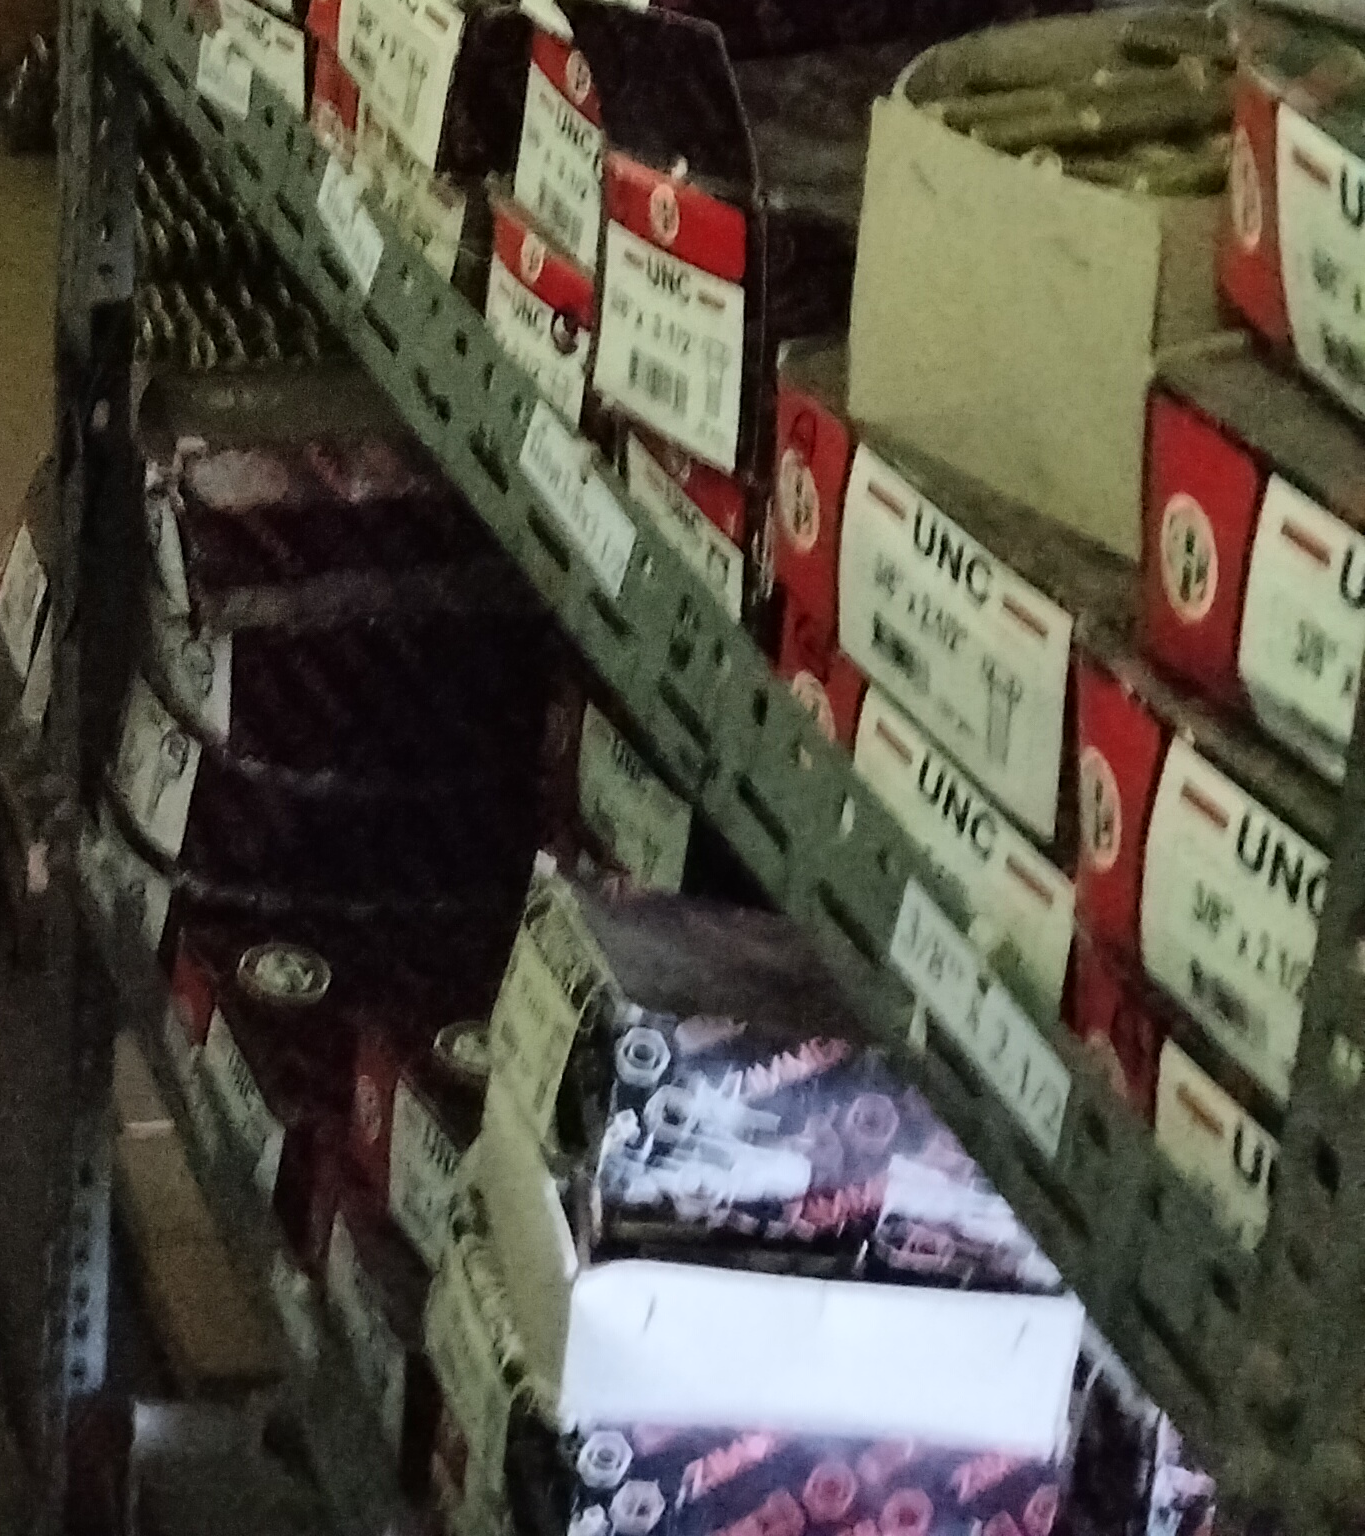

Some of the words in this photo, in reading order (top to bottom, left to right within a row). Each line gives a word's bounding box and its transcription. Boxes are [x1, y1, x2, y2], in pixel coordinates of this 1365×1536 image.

[555, 103, 593, 160] UNC
[646, 254, 690, 305] UNC
[913, 505, 992, 606] UNC
[917, 753, 999, 863] UNC
